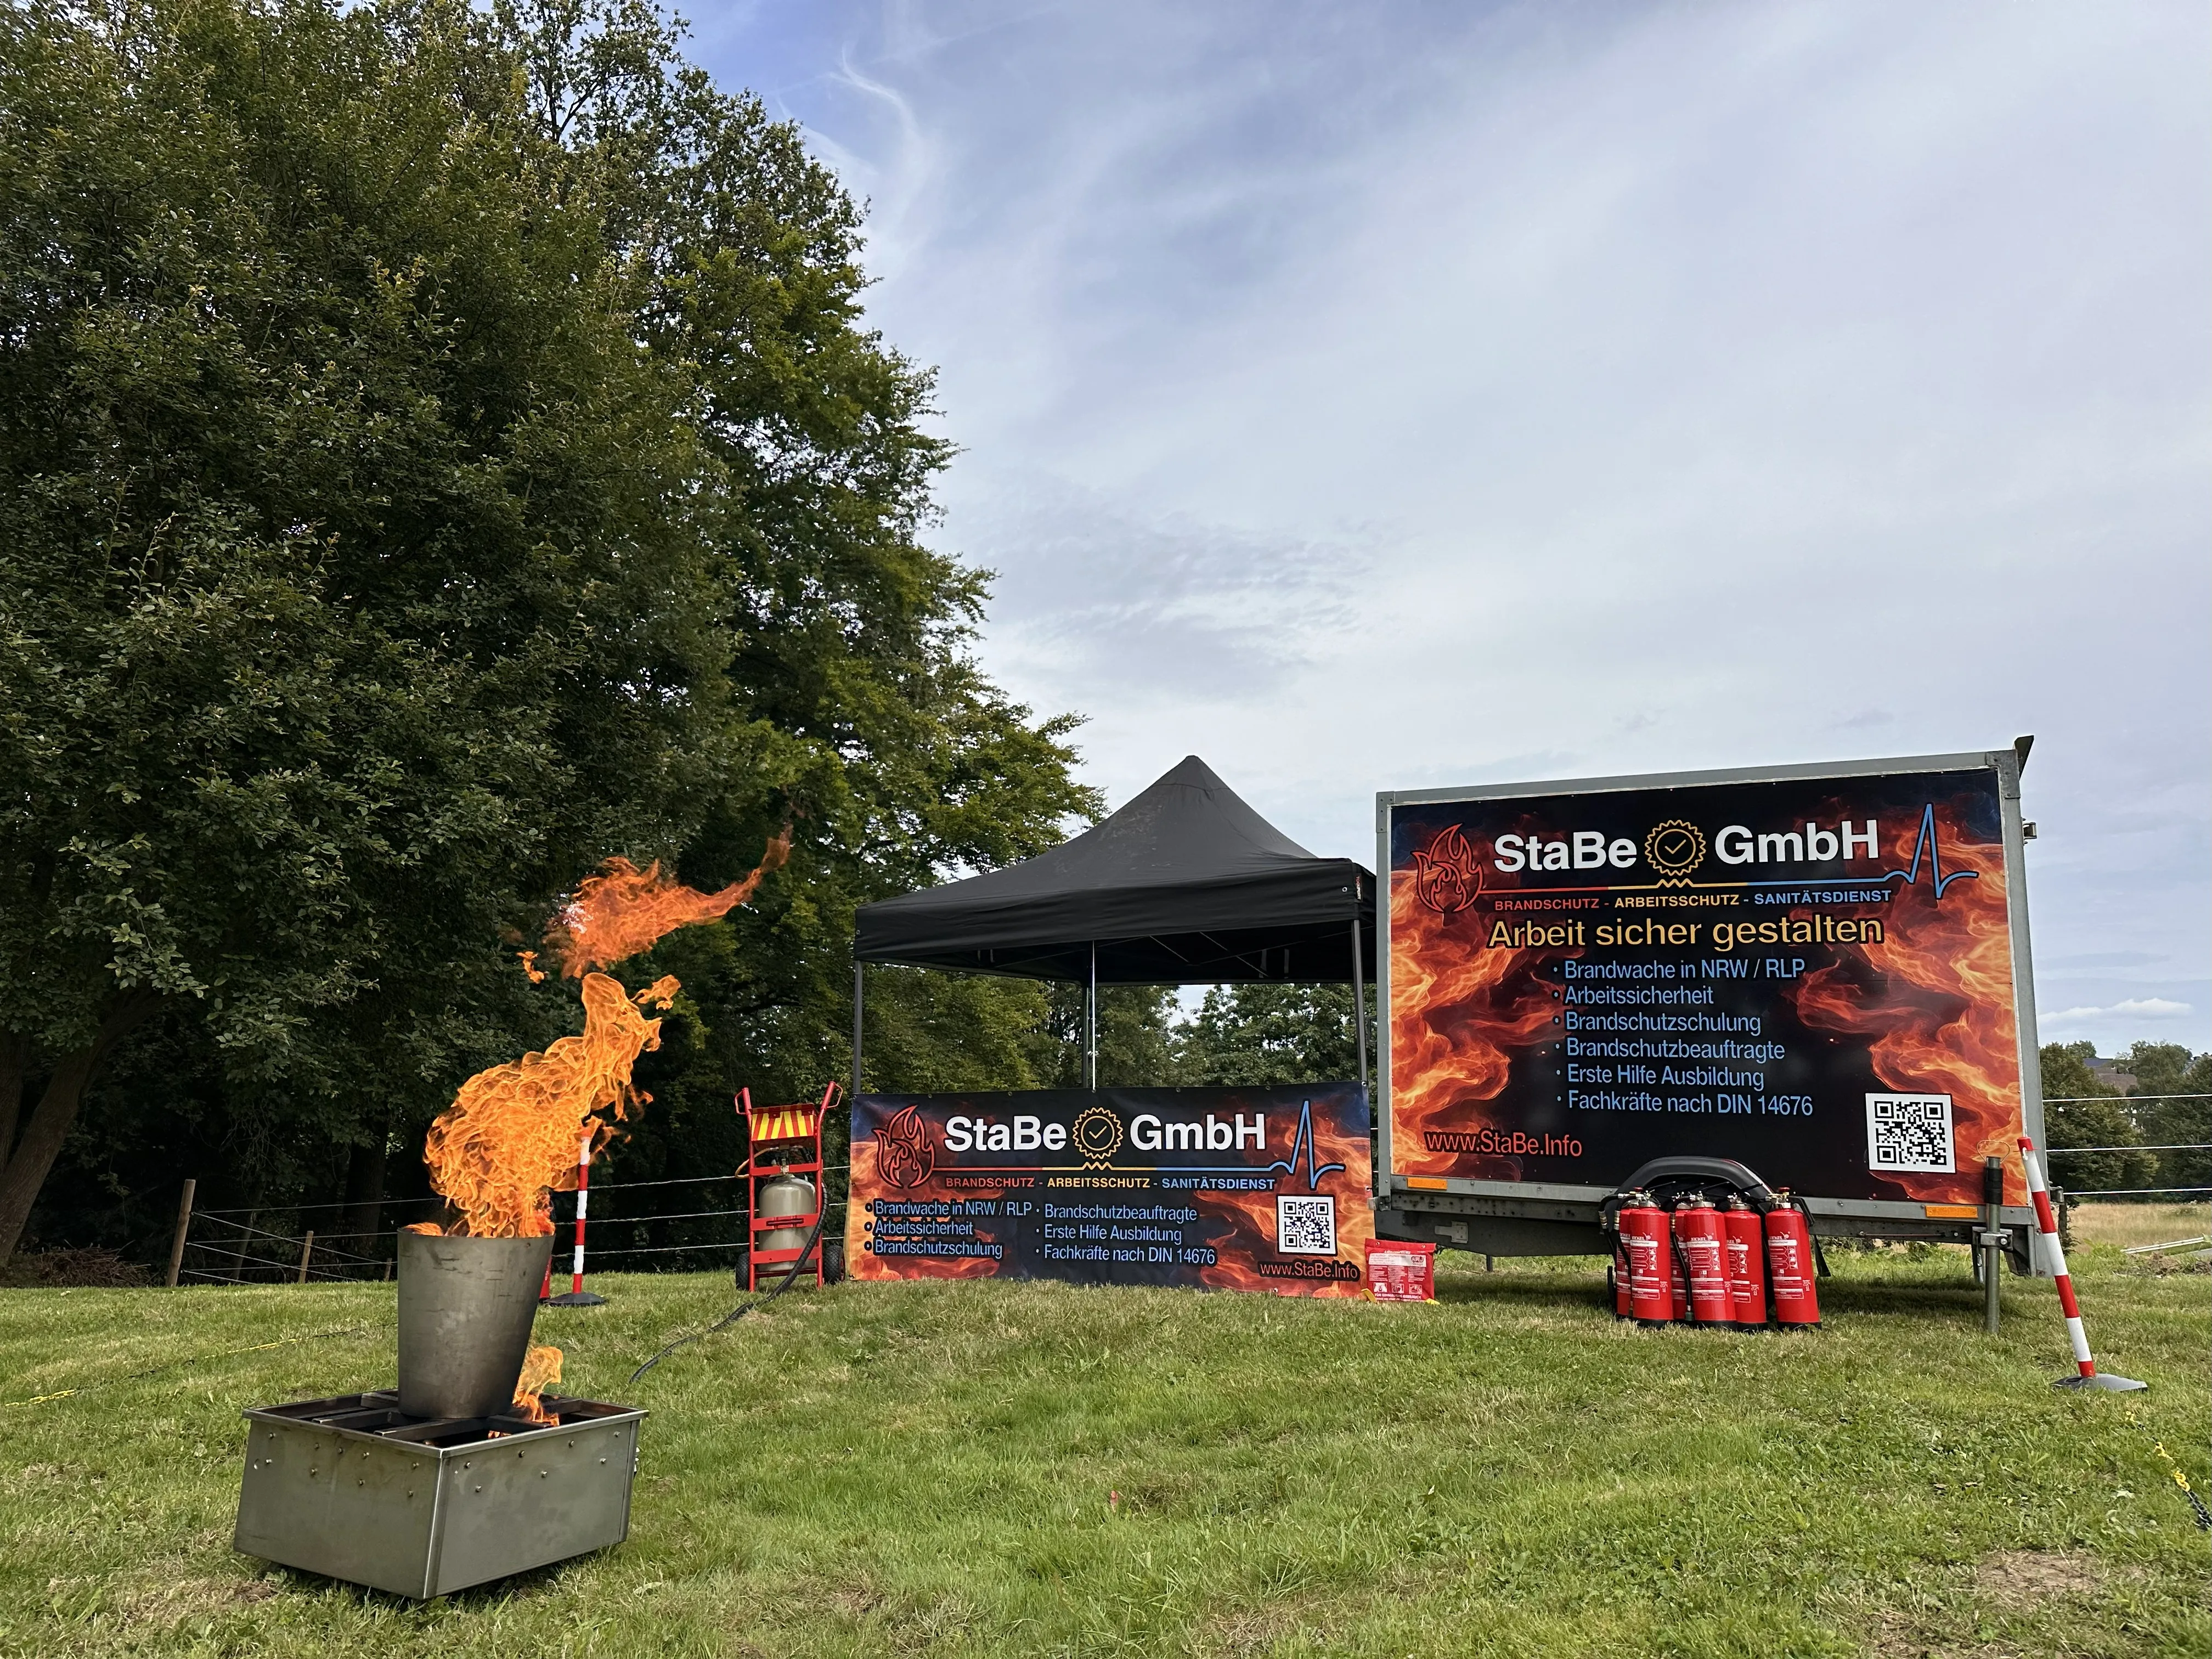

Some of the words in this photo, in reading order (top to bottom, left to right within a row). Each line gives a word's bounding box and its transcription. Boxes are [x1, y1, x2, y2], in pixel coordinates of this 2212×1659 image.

[1494, 831, 1637, 872] StaBe
[1715, 819, 1879, 865] GmbH
[1495, 898, 1599, 911] BRANDSCHUTZ
[1615, 894, 1740, 908] ARBEITSSCHUTZ
[1754, 890, 1892, 905] SANITÄTSDIENST
[1488, 919, 1585, 946] Arbeit
[1595, 918, 1702, 945] sicher
[1712, 914, 1884, 952] gestalten
[1565, 960, 1675, 979] Brandwache
[1681, 960, 1696, 978] in
[1702, 959, 1748, 978] NRW
[1766, 958, 1805, 978] RLP
[1565, 985, 1714, 1005] Arbeitssicherheit
[1566, 1011, 1762, 1036] Brandschutzschulung
[1567, 1037, 1786, 1064] Brandschutzbeauftragte
[1568, 1063, 1612, 1084] Erste
[1618, 1064, 1656, 1085] Hilfe
[1661, 1065, 1764, 1091] Ausbildung
[1568, 1090, 1662, 1111] Fachkräfte
[1668, 1093, 1712, 1113] nach
[1718, 1093, 1751, 1114] DIN
[1757, 1095, 1813, 1116] 14676
[944, 1115, 1066, 1152] StaBe
[1130, 1114, 1265, 1150] GmbH
[1426, 1130, 1582, 1157] www.StaBe.Info
[946, 1177, 1035, 1188] BRANDSCHUTZ
[1047, 1177, 1150, 1188] ARBEITSSCHUTZ
[1162, 1176, 1276, 1189] SANITÄTSDIENST
[875, 1201, 949, 1215] Brandwache
[952, 1201, 962, 1215] in
[966, 1201, 996, 1215] NRW
[1007, 1201, 1032, 1216] RLP
[1045, 1203, 1197, 1224] Brandschutzbeauftragte
[875, 1221, 973, 1235] Arbeitssicherheit
[1045, 1224, 1076, 1239] Erste
[1080, 1224, 1107, 1240] Hilfe
[1110, 1225, 1182, 1245] Ausbildung
[875, 1239, 1002, 1259] Brandschutzschulung
[1045, 1244, 1110, 1261] Fachkräfte
[1113, 1246, 1144, 1262] nach
[1148, 1247, 1172, 1262] DIN
[1177, 1248, 1215, 1265] 14676
[1260, 1262, 1358, 1279] www.StaBe.Info
